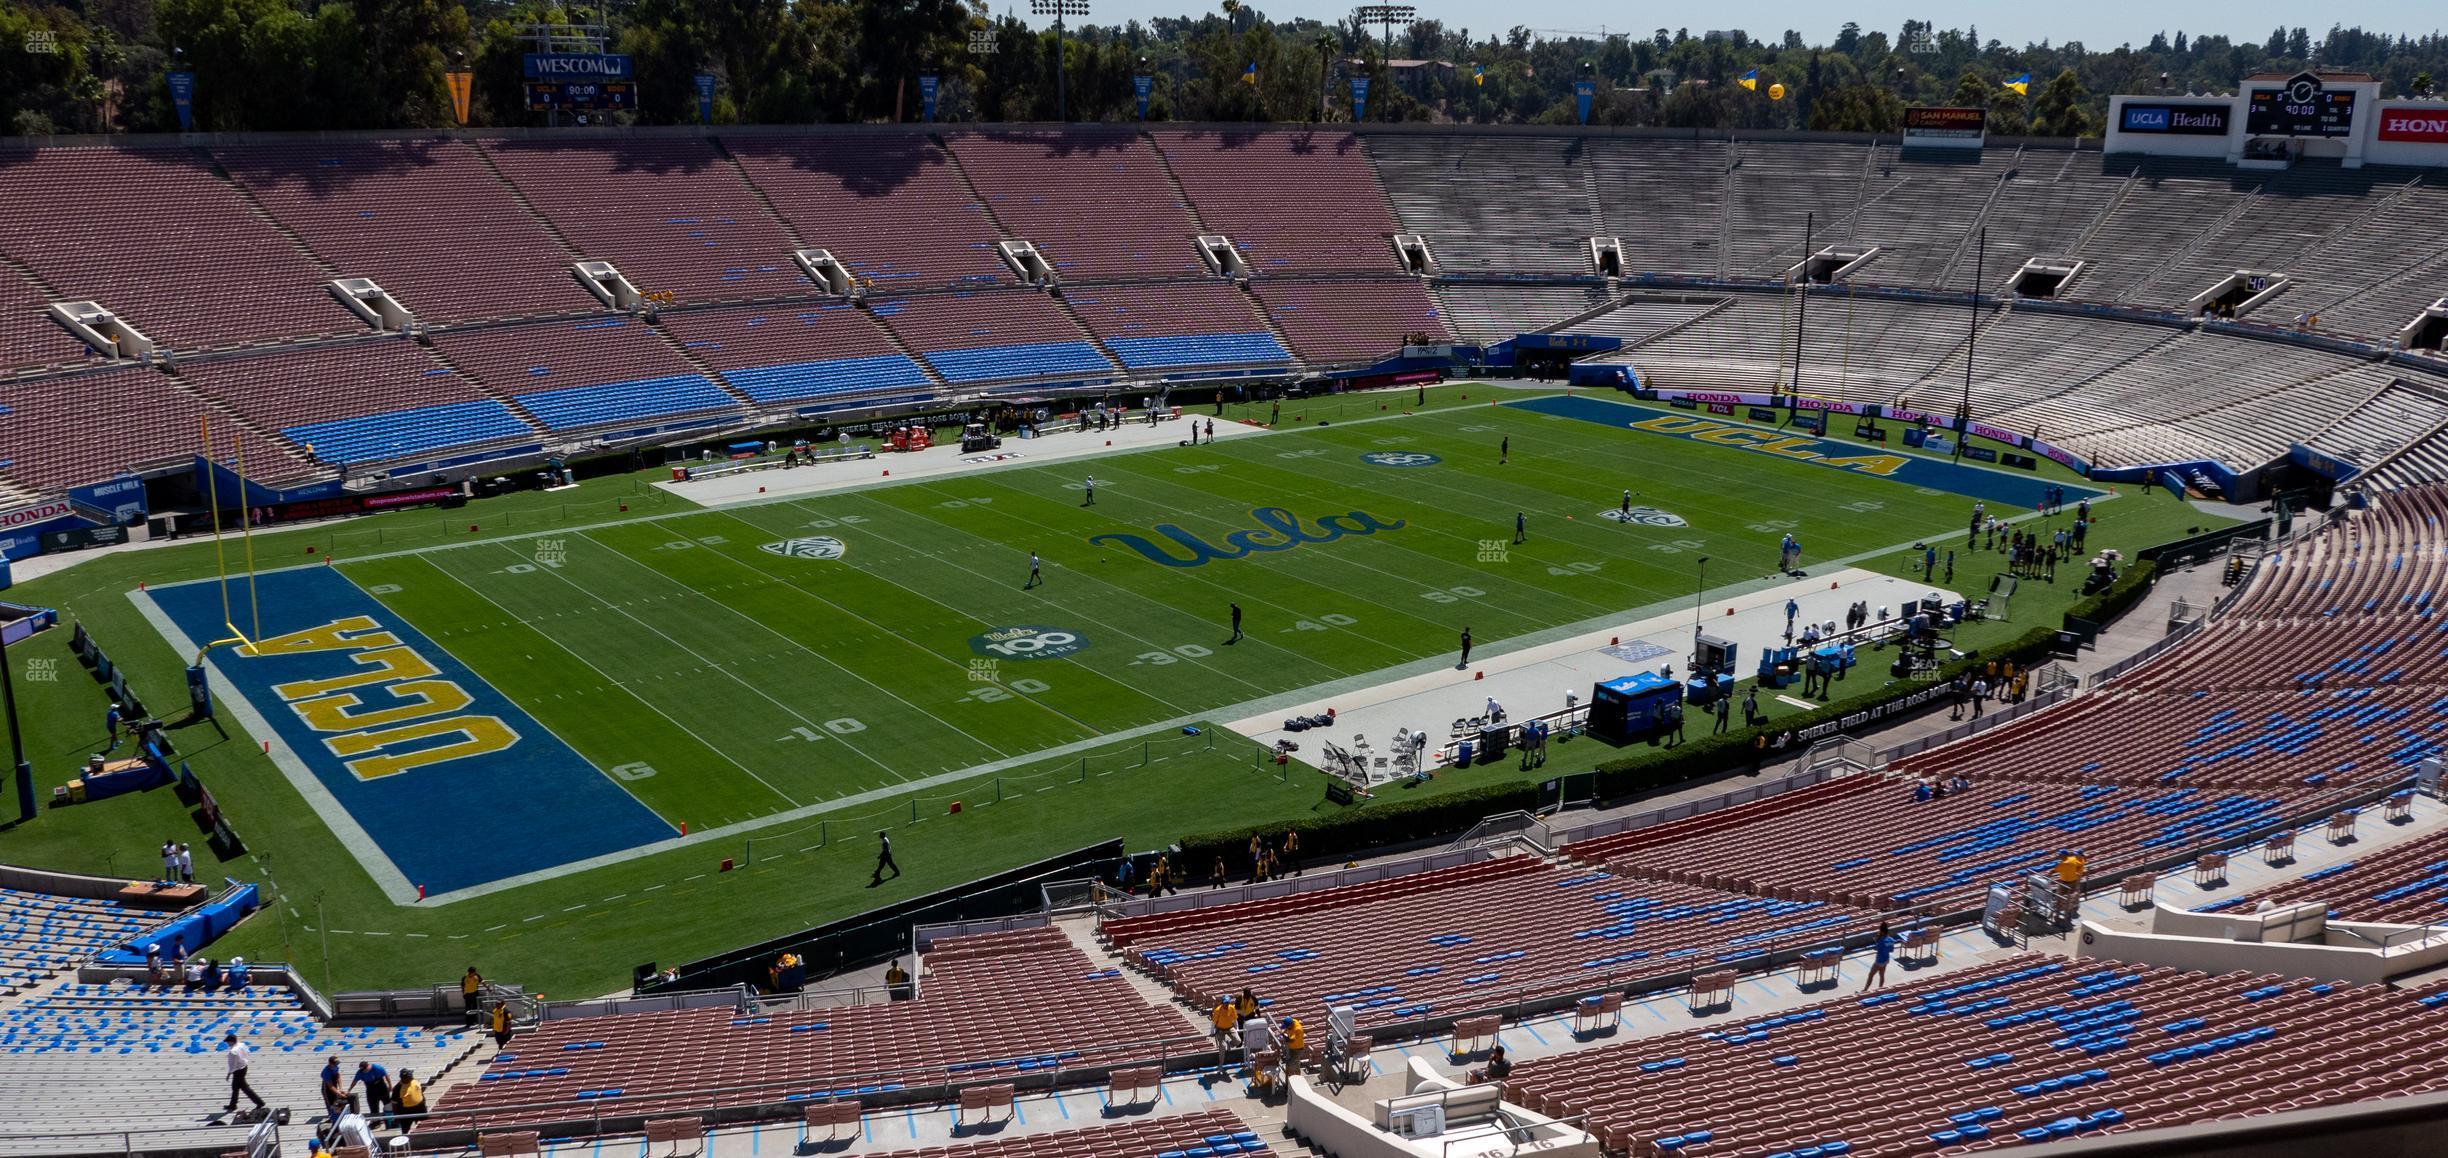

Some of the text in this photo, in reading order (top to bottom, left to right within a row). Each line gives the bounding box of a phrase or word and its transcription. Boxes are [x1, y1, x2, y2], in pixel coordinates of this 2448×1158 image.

[536, 58, 604, 73] WESCOM
[1920, 111, 1981, 121] SAN MANUEL
[2131, 112, 2222, 128] UCLA Health
[2249, 277, 2266, 290] 40
[1686, 392, 1743, 404] HONDA
[1711, 403, 1730, 414] TCL
[837, 423, 870, 434] SPIEKER
[927, 414, 948, 423] ROSE
[1974, 425, 2014, 443] HONDA
[1630, 415, 1910, 475] UCLA
[2047, 447, 2075, 466] HONDA
[93, 480, 140, 497] MUSCLE MILK
[369, 490, 450, 505] shoprosebowlstadium.com
[1088, 507, 1406, 568] Ucla
[1419, 586, 1487, 603] 50
[1294, 613, 1359, 631] 40
[985, 632, 1076, 655] 100
[1023, 644, 1079, 660] YEARS
[1136, 644, 1214, 666] 30
[232, 615, 522, 782] UCLA
[967, 678, 1051, 703] 20
[1797, 720, 1838, 742] SPIEKER
[1840, 711, 1869, 730] FIELD
[1870, 705, 1885, 720] AT
[1885, 698, 1905, 715] THE
[1905, 690, 1929, 708] ROSE
[790, 717, 868, 742] 10
[1528, 1139, 1555, 1151] 16
